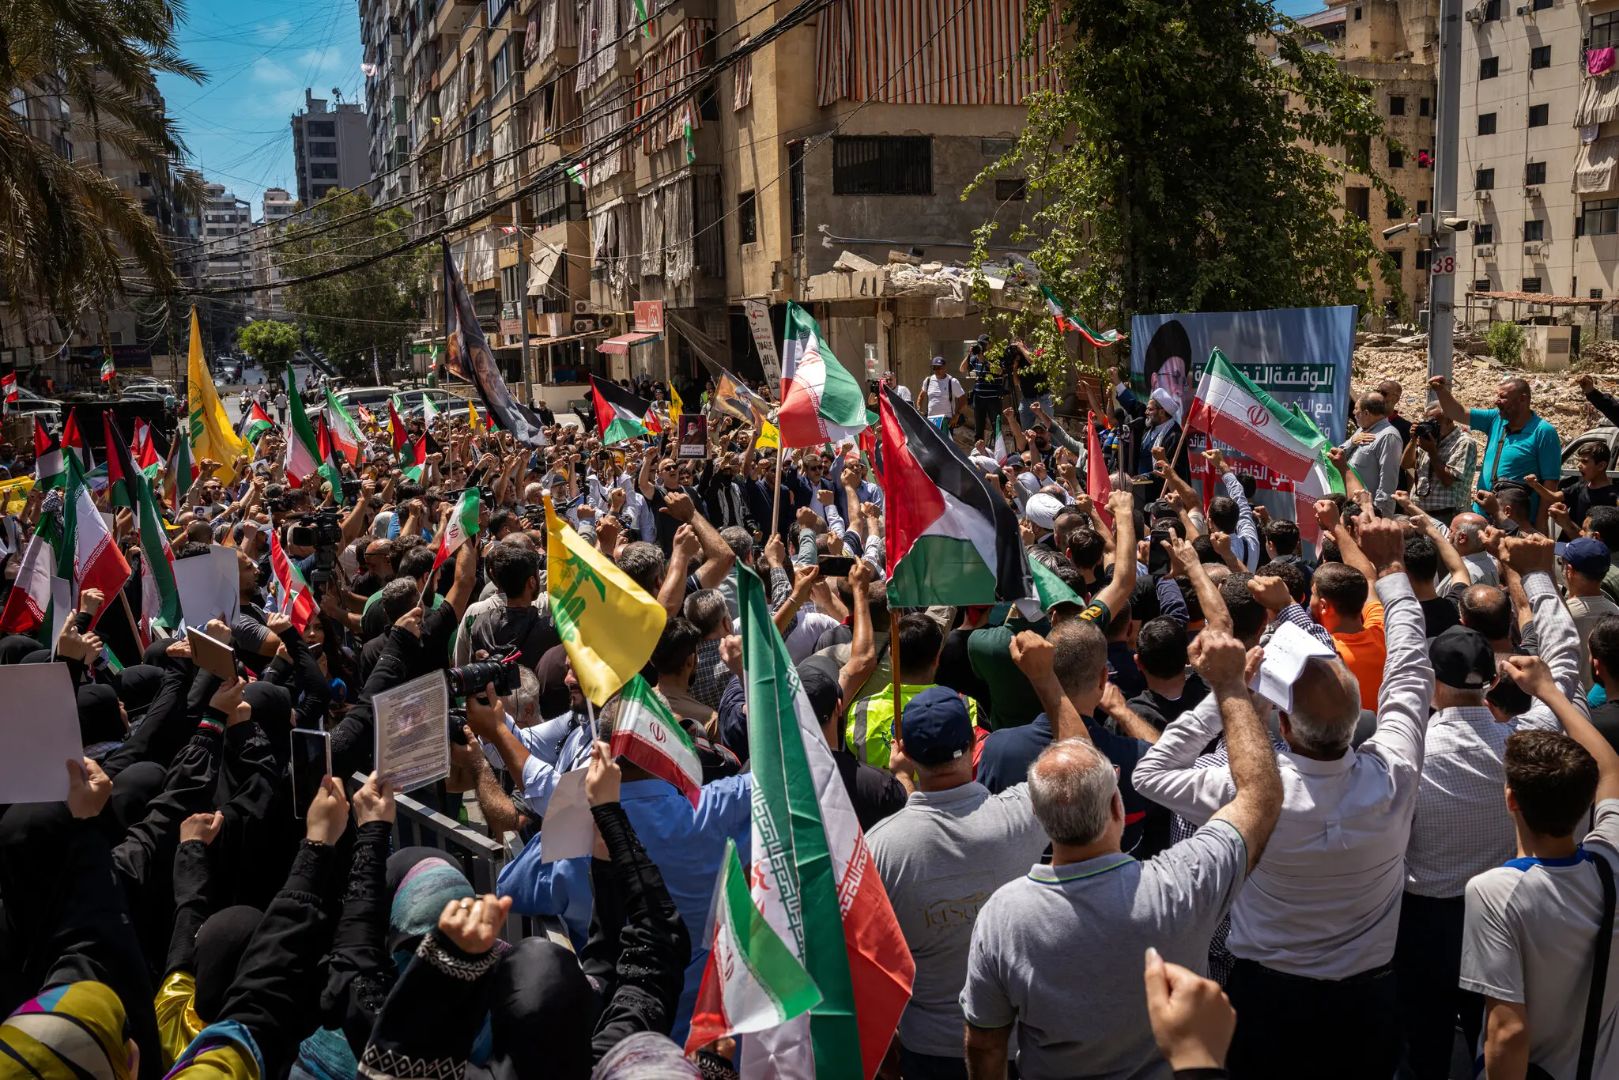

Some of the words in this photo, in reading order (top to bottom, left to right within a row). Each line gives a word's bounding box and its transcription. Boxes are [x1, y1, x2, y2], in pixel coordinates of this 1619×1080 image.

[1432, 257, 1454, 273] 38
[1274, 365, 1333, 391] الوقفة
[1314, 401, 1333, 418] مع
